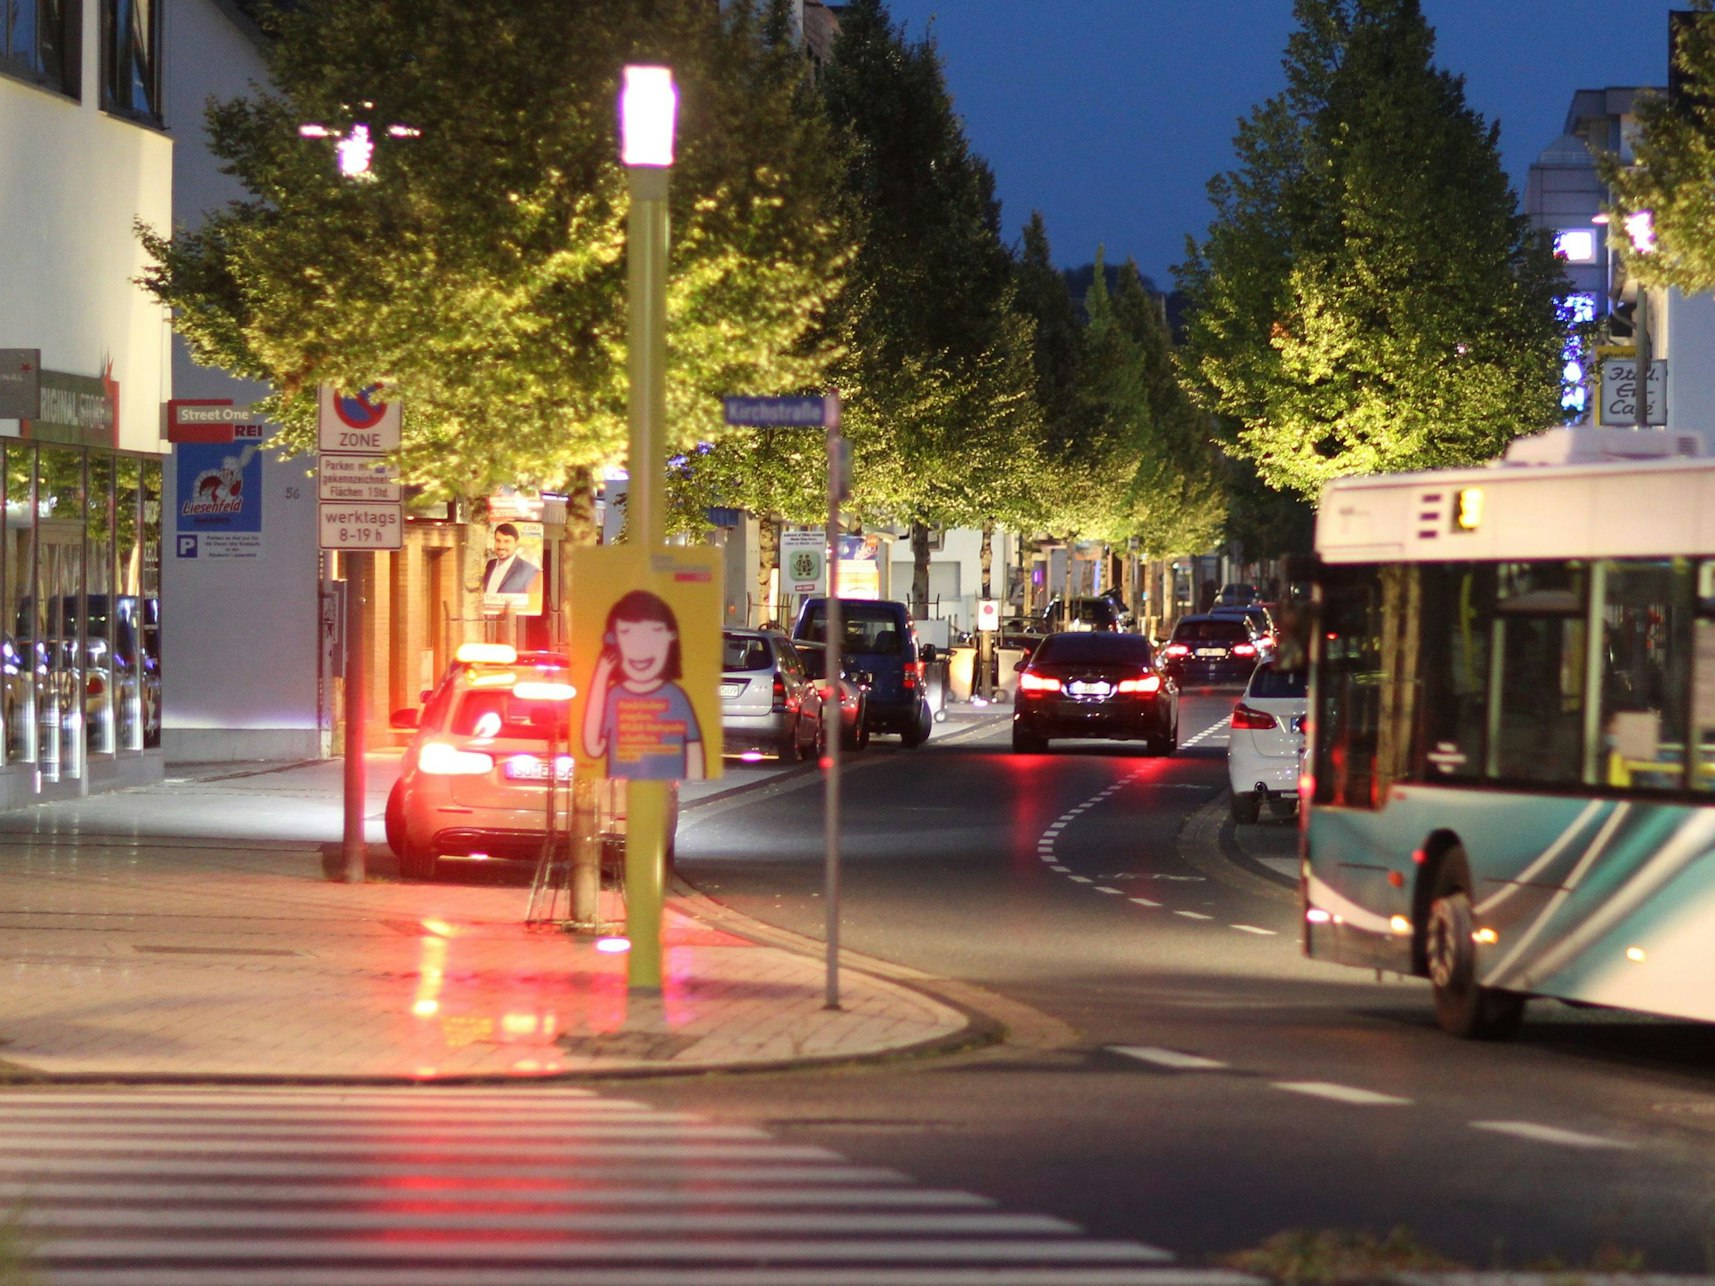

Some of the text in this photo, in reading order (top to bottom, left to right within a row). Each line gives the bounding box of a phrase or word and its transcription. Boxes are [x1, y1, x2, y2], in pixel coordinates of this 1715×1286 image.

[1609, 399, 1656, 415] Caé
[181, 409, 249, 421] Street One
[340, 432, 381, 447] ZONE
[325, 460, 355, 471] Parken
[330, 486, 363, 497] Flächen
[182, 498, 243, 515] Liesenfeld
[325, 511, 396, 528] werktags
[339, 528, 383, 542] 8-19 h
[180, 538, 195, 555] P
